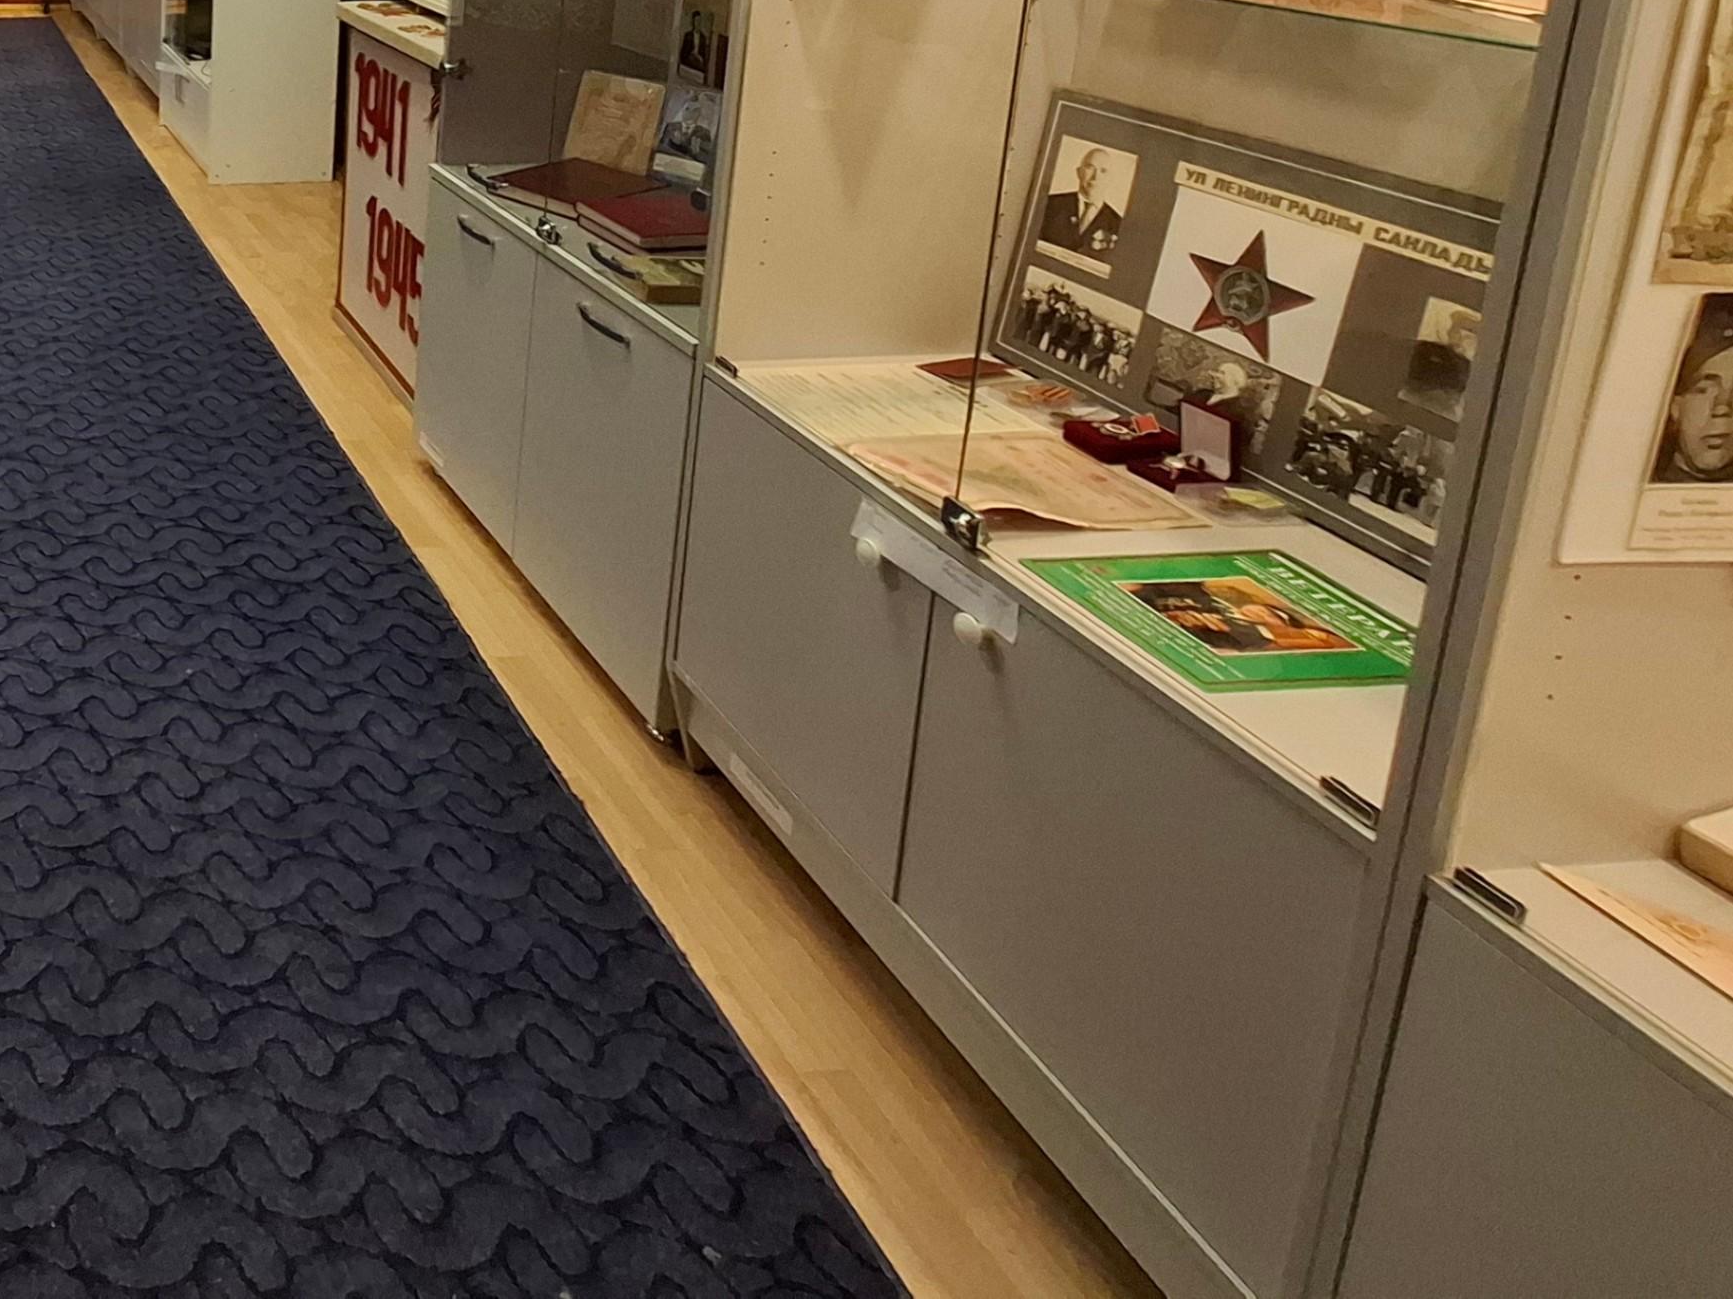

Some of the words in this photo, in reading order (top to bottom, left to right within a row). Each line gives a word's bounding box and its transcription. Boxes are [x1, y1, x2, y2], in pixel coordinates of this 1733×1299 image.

[354, 52, 411, 188] 1941
[365, 195, 426, 347] 1945
[1211, 176, 1364, 235] ЛЕНИНГРАДНЫ
